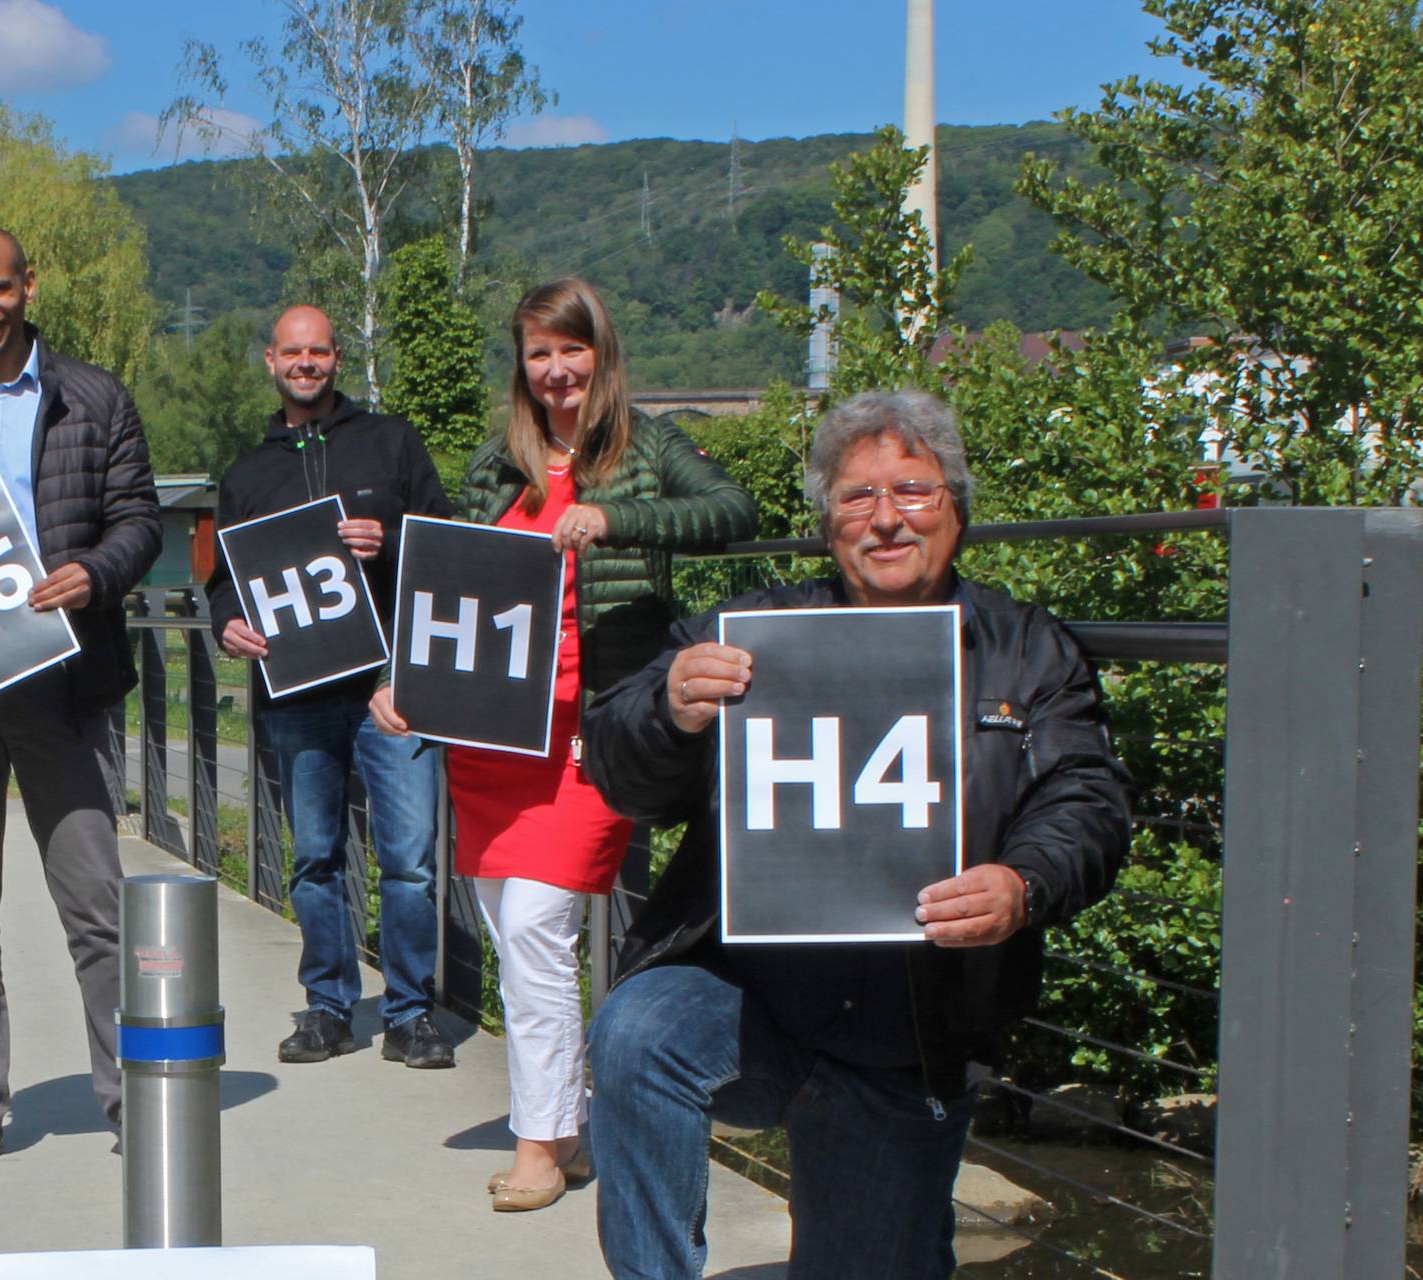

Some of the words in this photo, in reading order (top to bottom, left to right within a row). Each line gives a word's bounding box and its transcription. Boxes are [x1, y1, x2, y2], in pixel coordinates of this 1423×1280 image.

[248, 555, 357, 638] H3
[409, 590, 533, 680] H1
[745, 714, 941, 830] H4
